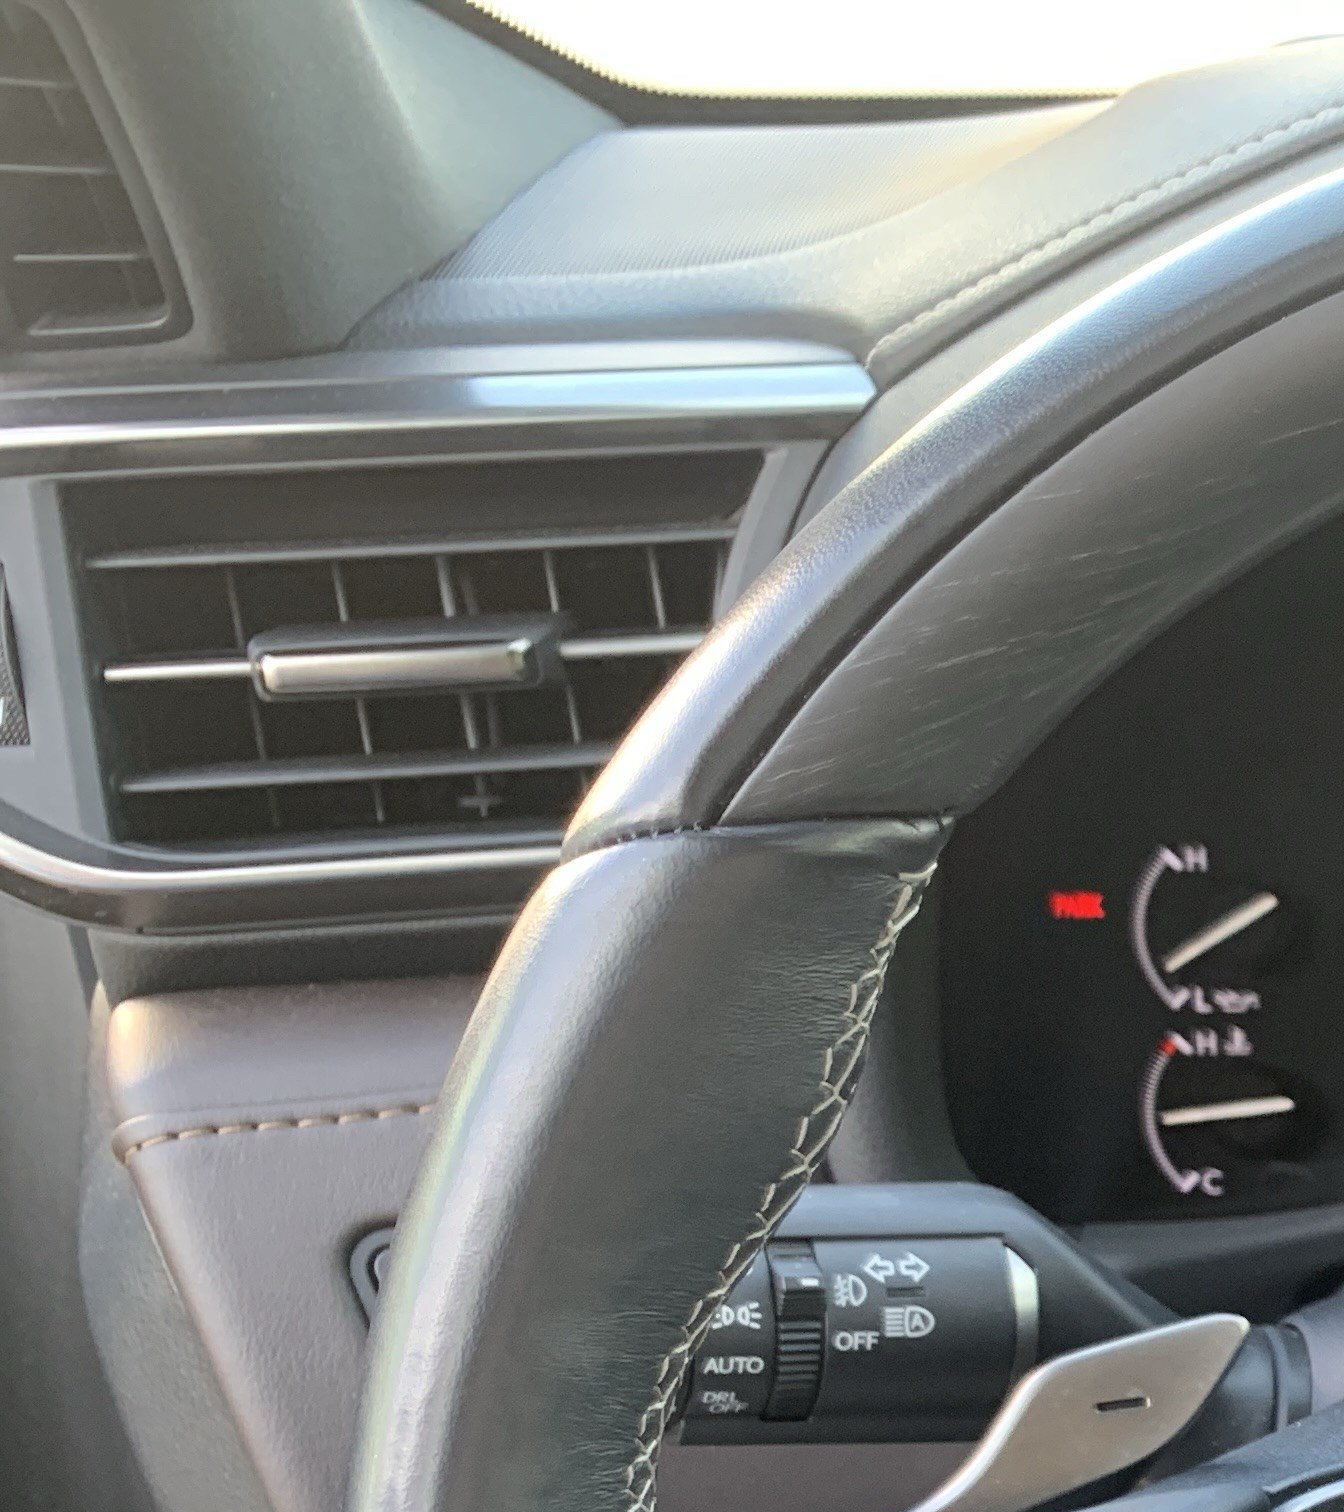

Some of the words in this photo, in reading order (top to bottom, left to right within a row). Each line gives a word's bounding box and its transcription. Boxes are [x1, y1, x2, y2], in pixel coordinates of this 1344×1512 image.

[1182, 844, 1208, 873] H
[1200, 1166, 1224, 1196] C
[832, 1331, 880, 1351] OFF
[703, 1356, 765, 1375] AUTO
